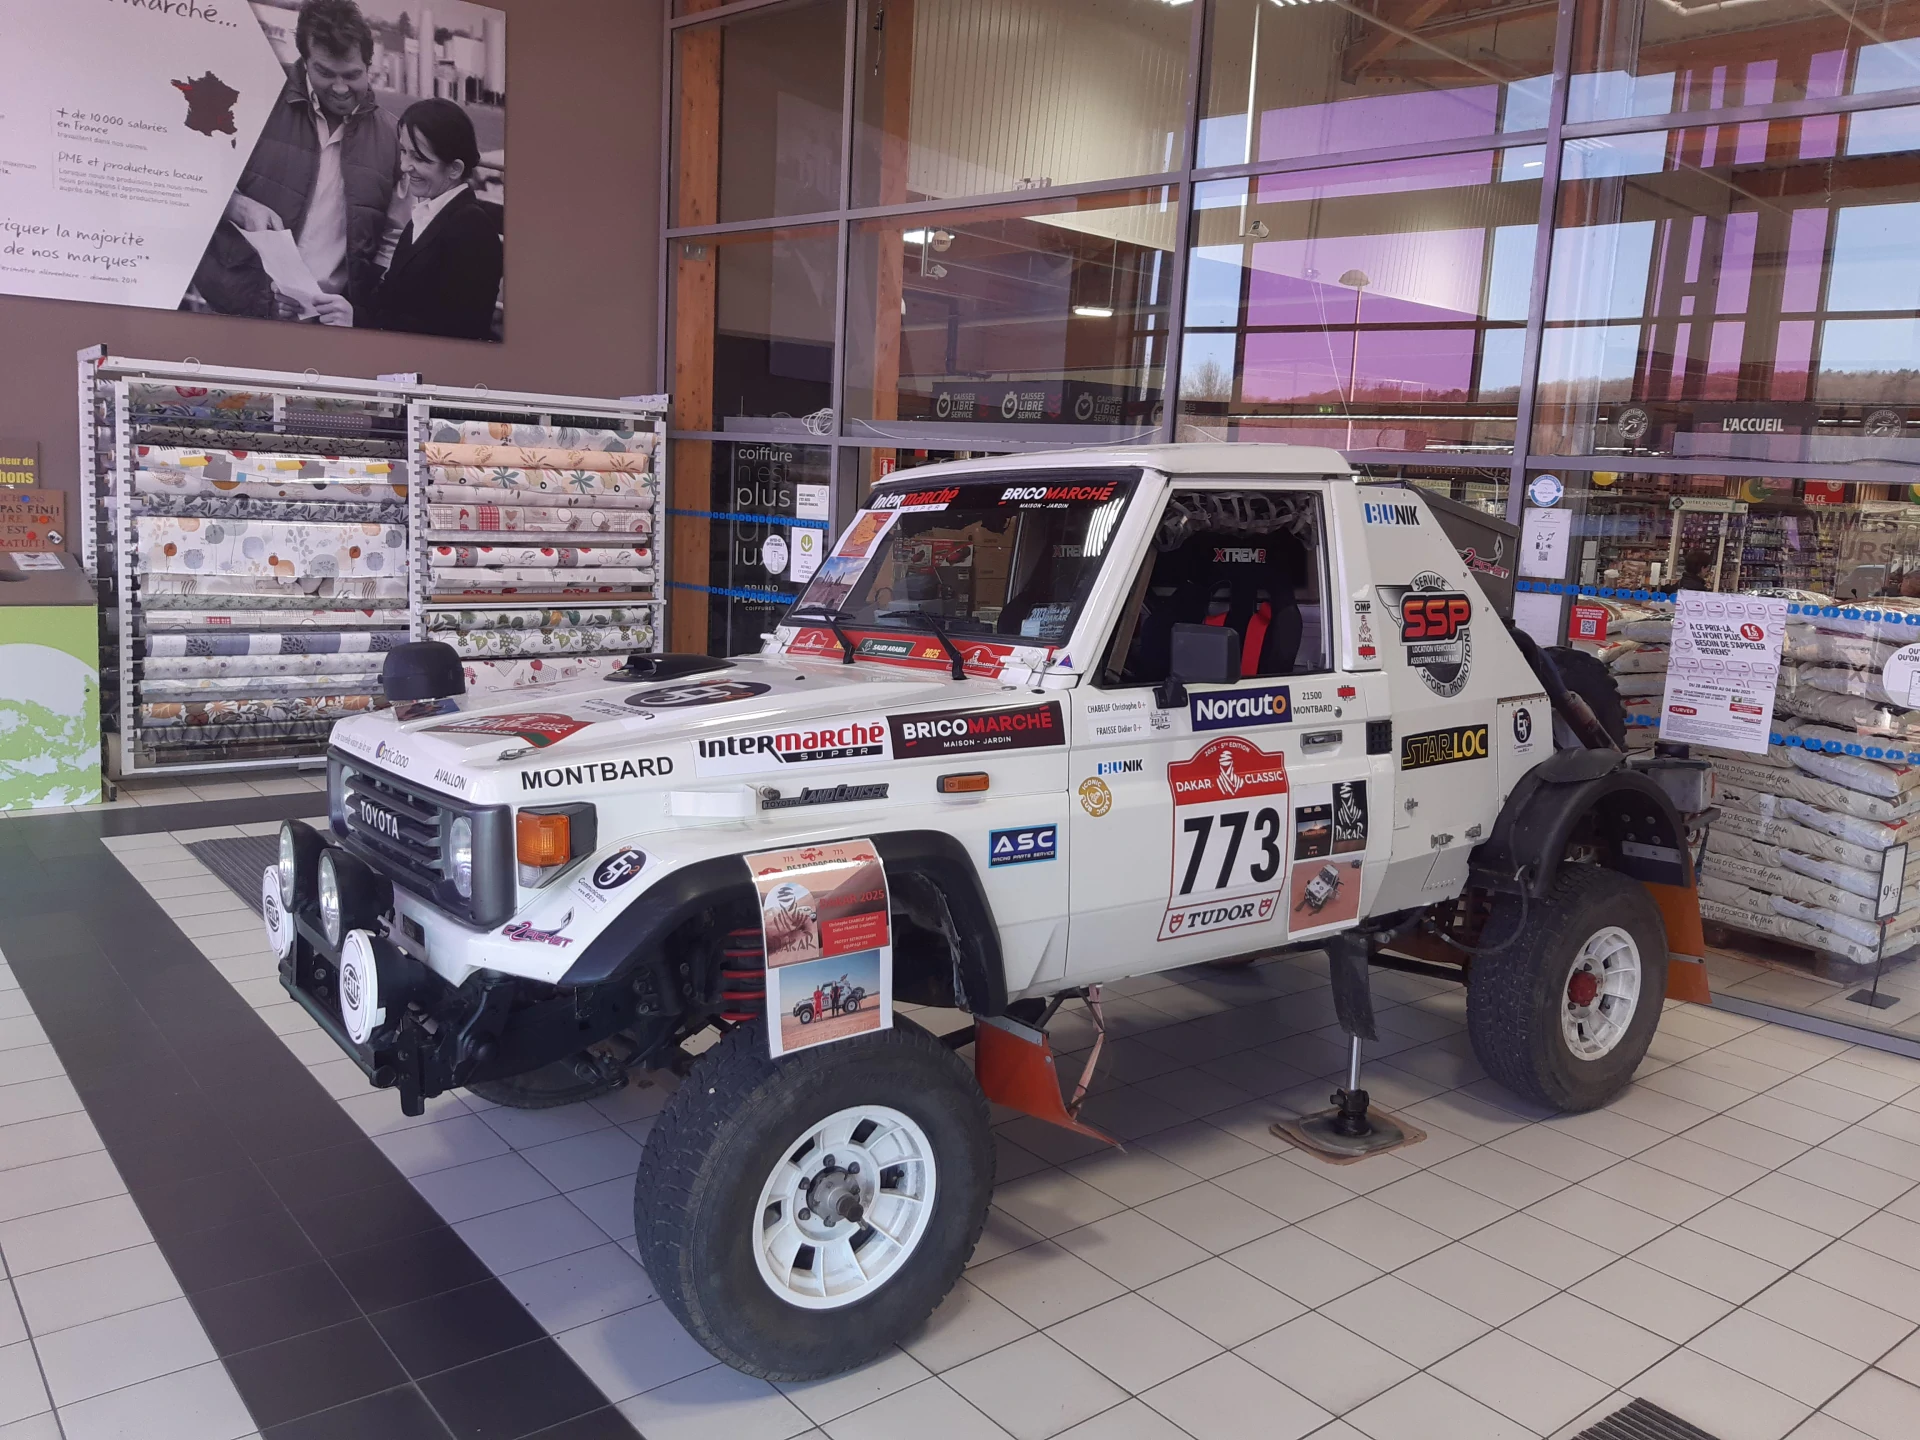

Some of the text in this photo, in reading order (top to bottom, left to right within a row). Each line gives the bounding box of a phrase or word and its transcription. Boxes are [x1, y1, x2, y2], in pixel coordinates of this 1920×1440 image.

[72, 110, 86, 119] de
[74, 121, 108, 134] France
[58, 151, 204, 182] PME et producteurs locaux
[56, 224, 70, 238] la
[76, 229, 145, 249] majorité
[4, 241, 25, 255] de
[32, 248, 59, 259] nos
[1021, 392, 1045, 400] CAISSES
[952, 401, 974, 410] LIBRE
[1019, 401, 1043, 411] LIBRE
[1095, 404, 1122, 415] LIBRE
[951, 411, 972, 419] SERVICE
[1018, 411, 1041, 419] SERVICE
[1723, 417, 1784, 432] L'ACCUEIL
[738, 447, 793, 462] coiffure
[22, 457, 34, 466] de
[738, 461, 790, 483] n'est
[737, 482, 791, 511] plus
[998, 481, 1117, 505] BRICOMARCHÉ
[1805, 494, 1826, 502] EN CE
[1415, 575, 1446, 590] SERVICE
[1355, 603, 1371, 611] OMP
[1403, 600, 1471, 637] SSP
[1695, 624, 1704, 632] CE
[1692, 631, 1702, 639] ILS
[1703, 632, 1723, 640] N'ONT
[1724, 633, 1741, 641] PLUS
[888, 645, 907, 653] ARABIA
[1412, 645, 1434, 653] LOCATION
[1695, 639, 1719, 648] BESOIN
[1731, 642, 1766, 650] S'APPELER
[922, 648, 941, 659] 2025
[1411, 656, 1436, 664] ASSISTANCE
[1421, 633, 1471, 695] SPORT PROMOTION
[1302, 691, 1322, 700] 21500
[1087, 702, 1137, 714] CHABEUF Christophe
[1196, 694, 1287, 721] Norauto
[1293, 704, 1333, 715] MONTBARD
[903, 706, 1052, 745] BRICOMARCHÉ
[1096, 725, 1132, 735] FRAISSE Didier
[699, 722, 884, 763] Intermarché
[943, 735, 1012, 748] MAISON JARDIN
[1229, 742, 1250, 753] EDITION
[801, 748, 868, 760] SUPER
[434, 769, 467, 790] AVALLON
[521, 756, 674, 790] MONTBARD
[1766, 770, 1776, 781] de
[1176, 771, 1283, 792] DAKAR CLASSIC
[1080, 779, 1111, 815] ICONIC CLASSIC CLUB
[764, 800, 799, 808] TOYOTA
[361, 800, 399, 839] TOYOTA
[1336, 823, 1364, 841] DAKAR
[994, 831, 1053, 853] ASC
[1179, 807, 1280, 895] 773
[1758, 867, 1768, 877] de
[578, 877, 607, 903] Communication
[861, 889, 885, 902] 2025
[1188, 903, 1255, 928] TUDOR
